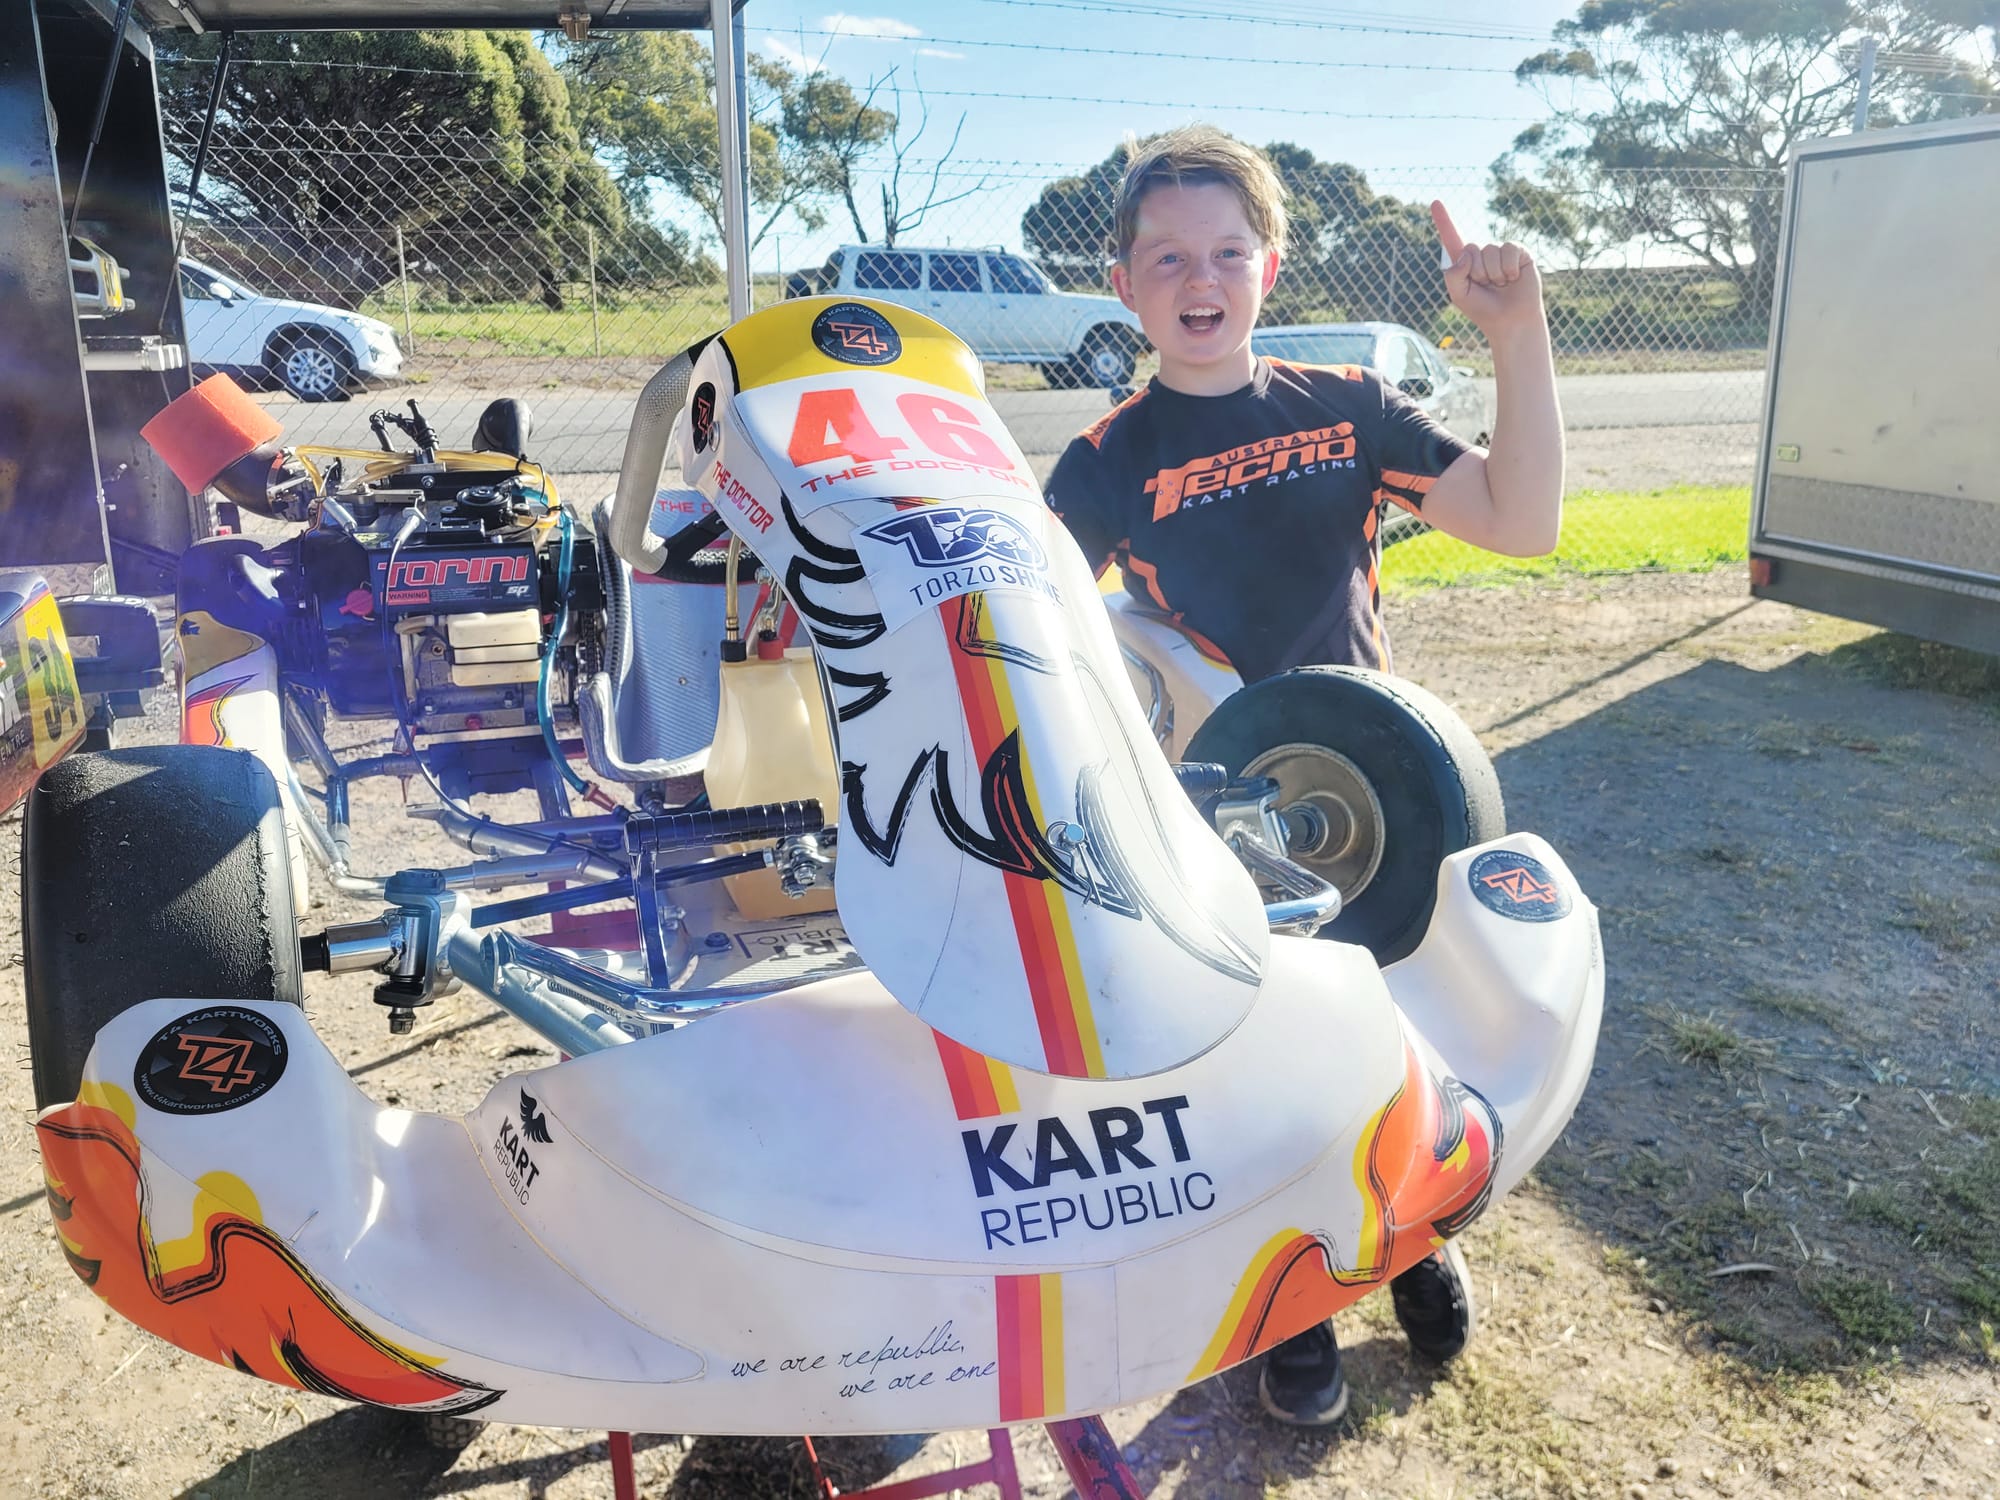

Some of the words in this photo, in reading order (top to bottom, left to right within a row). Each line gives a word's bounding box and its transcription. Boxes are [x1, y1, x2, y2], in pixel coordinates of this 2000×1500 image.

[787, 388, 1015, 468] 46
[1210, 428, 1341, 468] AUSTRALIA
[712, 460, 732, 490] THE
[726, 479, 774, 534] DOCTOR
[800, 464, 878, 494] THE
[888, 459, 1032, 491] DOCTOR
[1182, 484, 1249, 509] KART
[1266, 458, 1356, 486] RACING
[657, 500, 695, 513] THE
[388, 591, 428, 600] WARNING
[157, 1024, 183, 1043] T4
[187, 1010, 282, 1056] KARTWORKS
[176, 1033, 257, 1094] T4
[140, 1071, 268, 1111] www.t4kartworks.com.au
[500, 1115, 540, 1188] KART
[961, 1095, 1191, 1198] KART
[493, 1138, 530, 1206] REPUBLIC
[981, 1172, 1216, 1250] REPUBLIC
[731, 1358, 769, 1377] we
[779, 1354, 828, 1371] are
[838, 1378, 877, 1398] we
[888, 1369, 936, 1390] are
[944, 1360, 997, 1382] one
